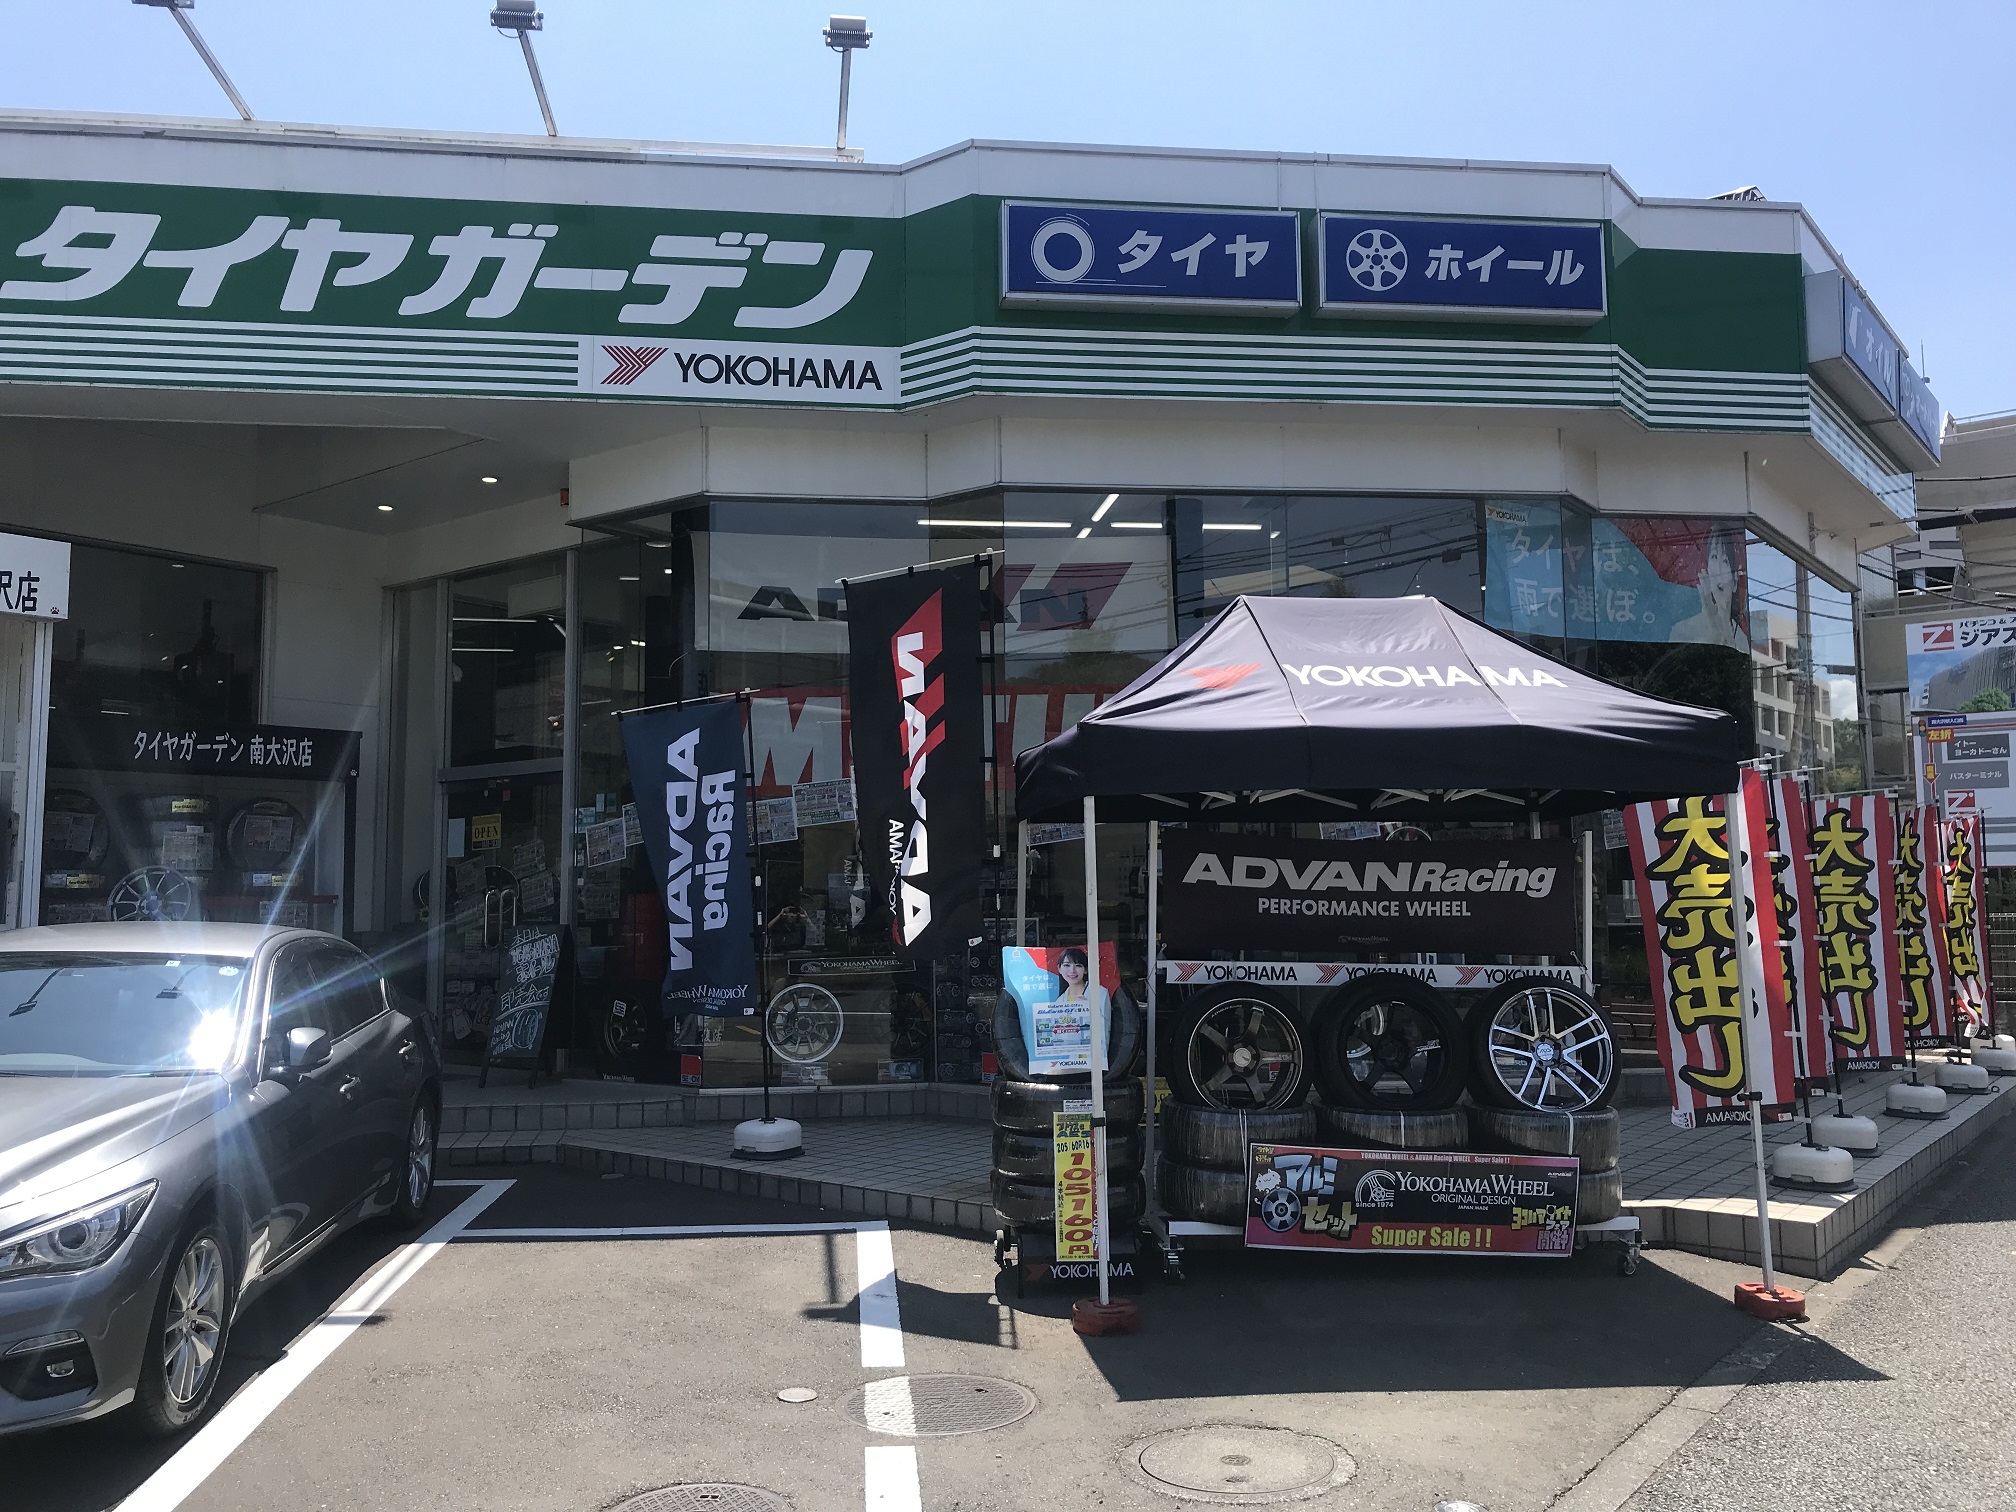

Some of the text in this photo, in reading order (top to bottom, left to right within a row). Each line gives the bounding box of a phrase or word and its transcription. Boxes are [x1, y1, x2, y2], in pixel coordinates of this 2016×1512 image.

[1118, 230, 1270, 279] タイヤ
[1425, 244, 1585, 286] ホイール
[0, 206, 873, 328] タイヤガーデン
[674, 353, 882, 390] YOKOHAMA
[1495, 510, 1527, 523] YOKOHAMA
[1282, 663, 1568, 688] YOKOHAMA
[1928, 729, 1952, 741] 左折
[1954, 739, 1977, 748] イトー
[133, 730, 313, 768] タイヤガーデン 南大沢店
[1955, 746, 2008, 757] ヨーカドーさん
[474, 824, 499, 840] OPEN
[1257, 897, 1472, 917] PERFORMANCE WHEEL
[1205, 964, 1298, 981] YOKOHAMA
[1273, 1154, 1338, 1195] アルミ
[1431, 1193, 1517, 1206] ORIGINAL DESIGN
[1301, 1196, 1358, 1238] セット
[1371, 1225, 1425, 1247] Super
[1429, 1226, 1471, 1246] Sale
[1050, 1262, 1135, 1279] YOKOHMA
